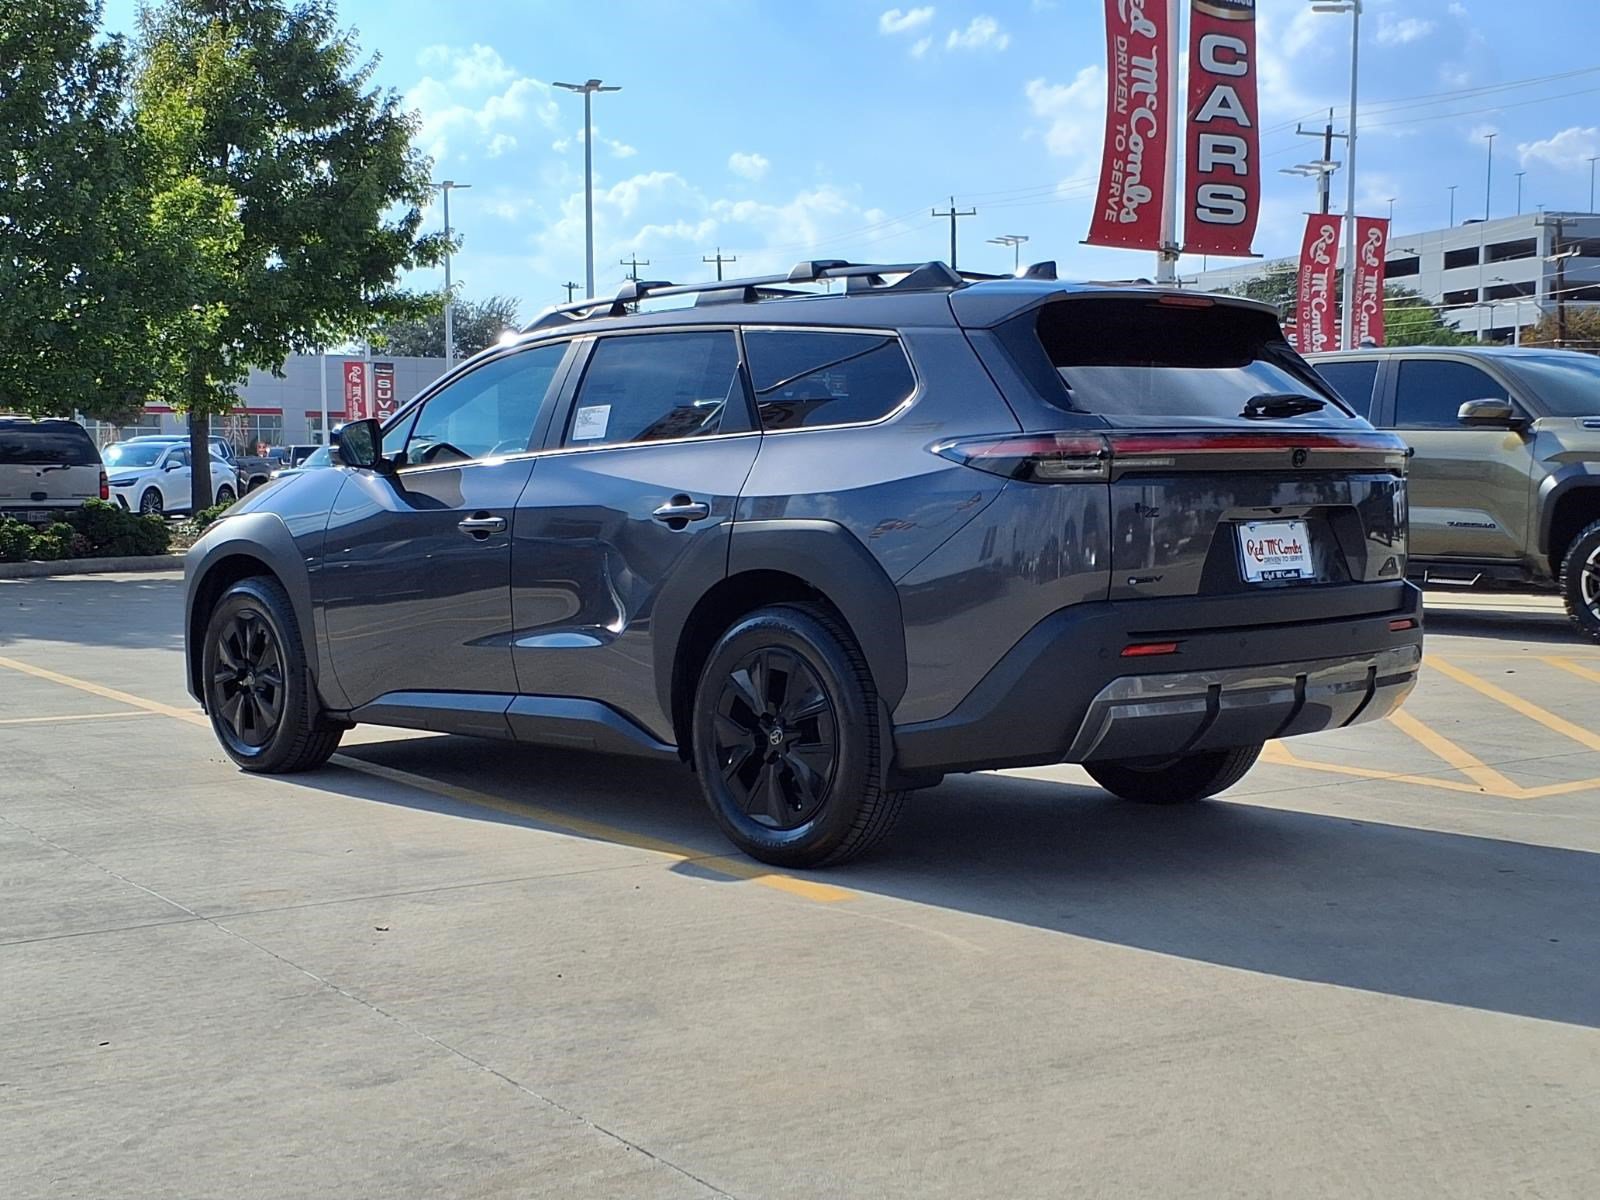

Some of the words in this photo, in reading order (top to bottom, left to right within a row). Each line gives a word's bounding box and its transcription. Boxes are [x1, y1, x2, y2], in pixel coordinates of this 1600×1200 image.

[1117, 0, 1157, 39] ed
[1115, 36, 1128, 115] DRIVEN
[1115, 124, 1127, 152] TO
[1119, 45, 1158, 224] McCombs
[1194, 33, 1252, 226] CARS
[1105, 159, 1123, 223] SERVE
[1309, 224, 1335, 265] Red
[1361, 227, 1383, 268] Red
[1302, 264, 1312, 303] DRIVEN
[1302, 307, 1311, 320] TO
[1311, 267, 1329, 353] McCombs
[1302, 323, 1312, 353] SERVE
[1246, 538, 1264, 563] Red
[1264, 538, 1303, 556] McCombs
[1264, 556, 1282, 565] DRIVEN
